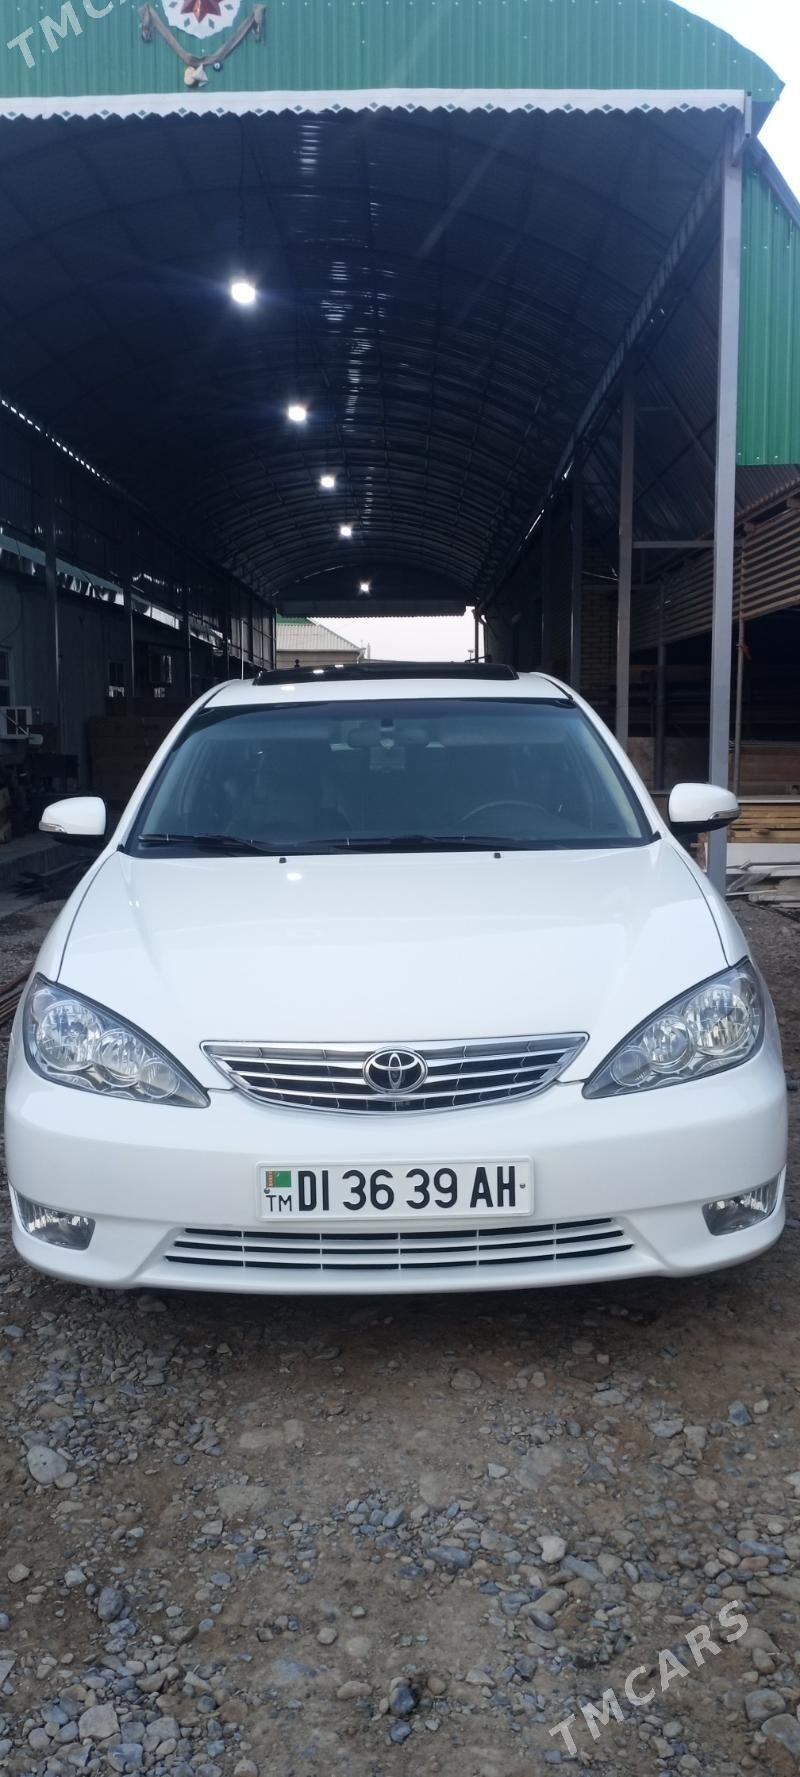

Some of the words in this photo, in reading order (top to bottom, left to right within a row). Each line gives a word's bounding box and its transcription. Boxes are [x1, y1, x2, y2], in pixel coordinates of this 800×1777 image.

[265, 1194, 292, 1212] TM
[297, 1169, 330, 1212] DI
[342, 1169, 395, 1211] 36
[405, 1167, 458, 1209] 39
[469, 1165, 516, 1208] AH
